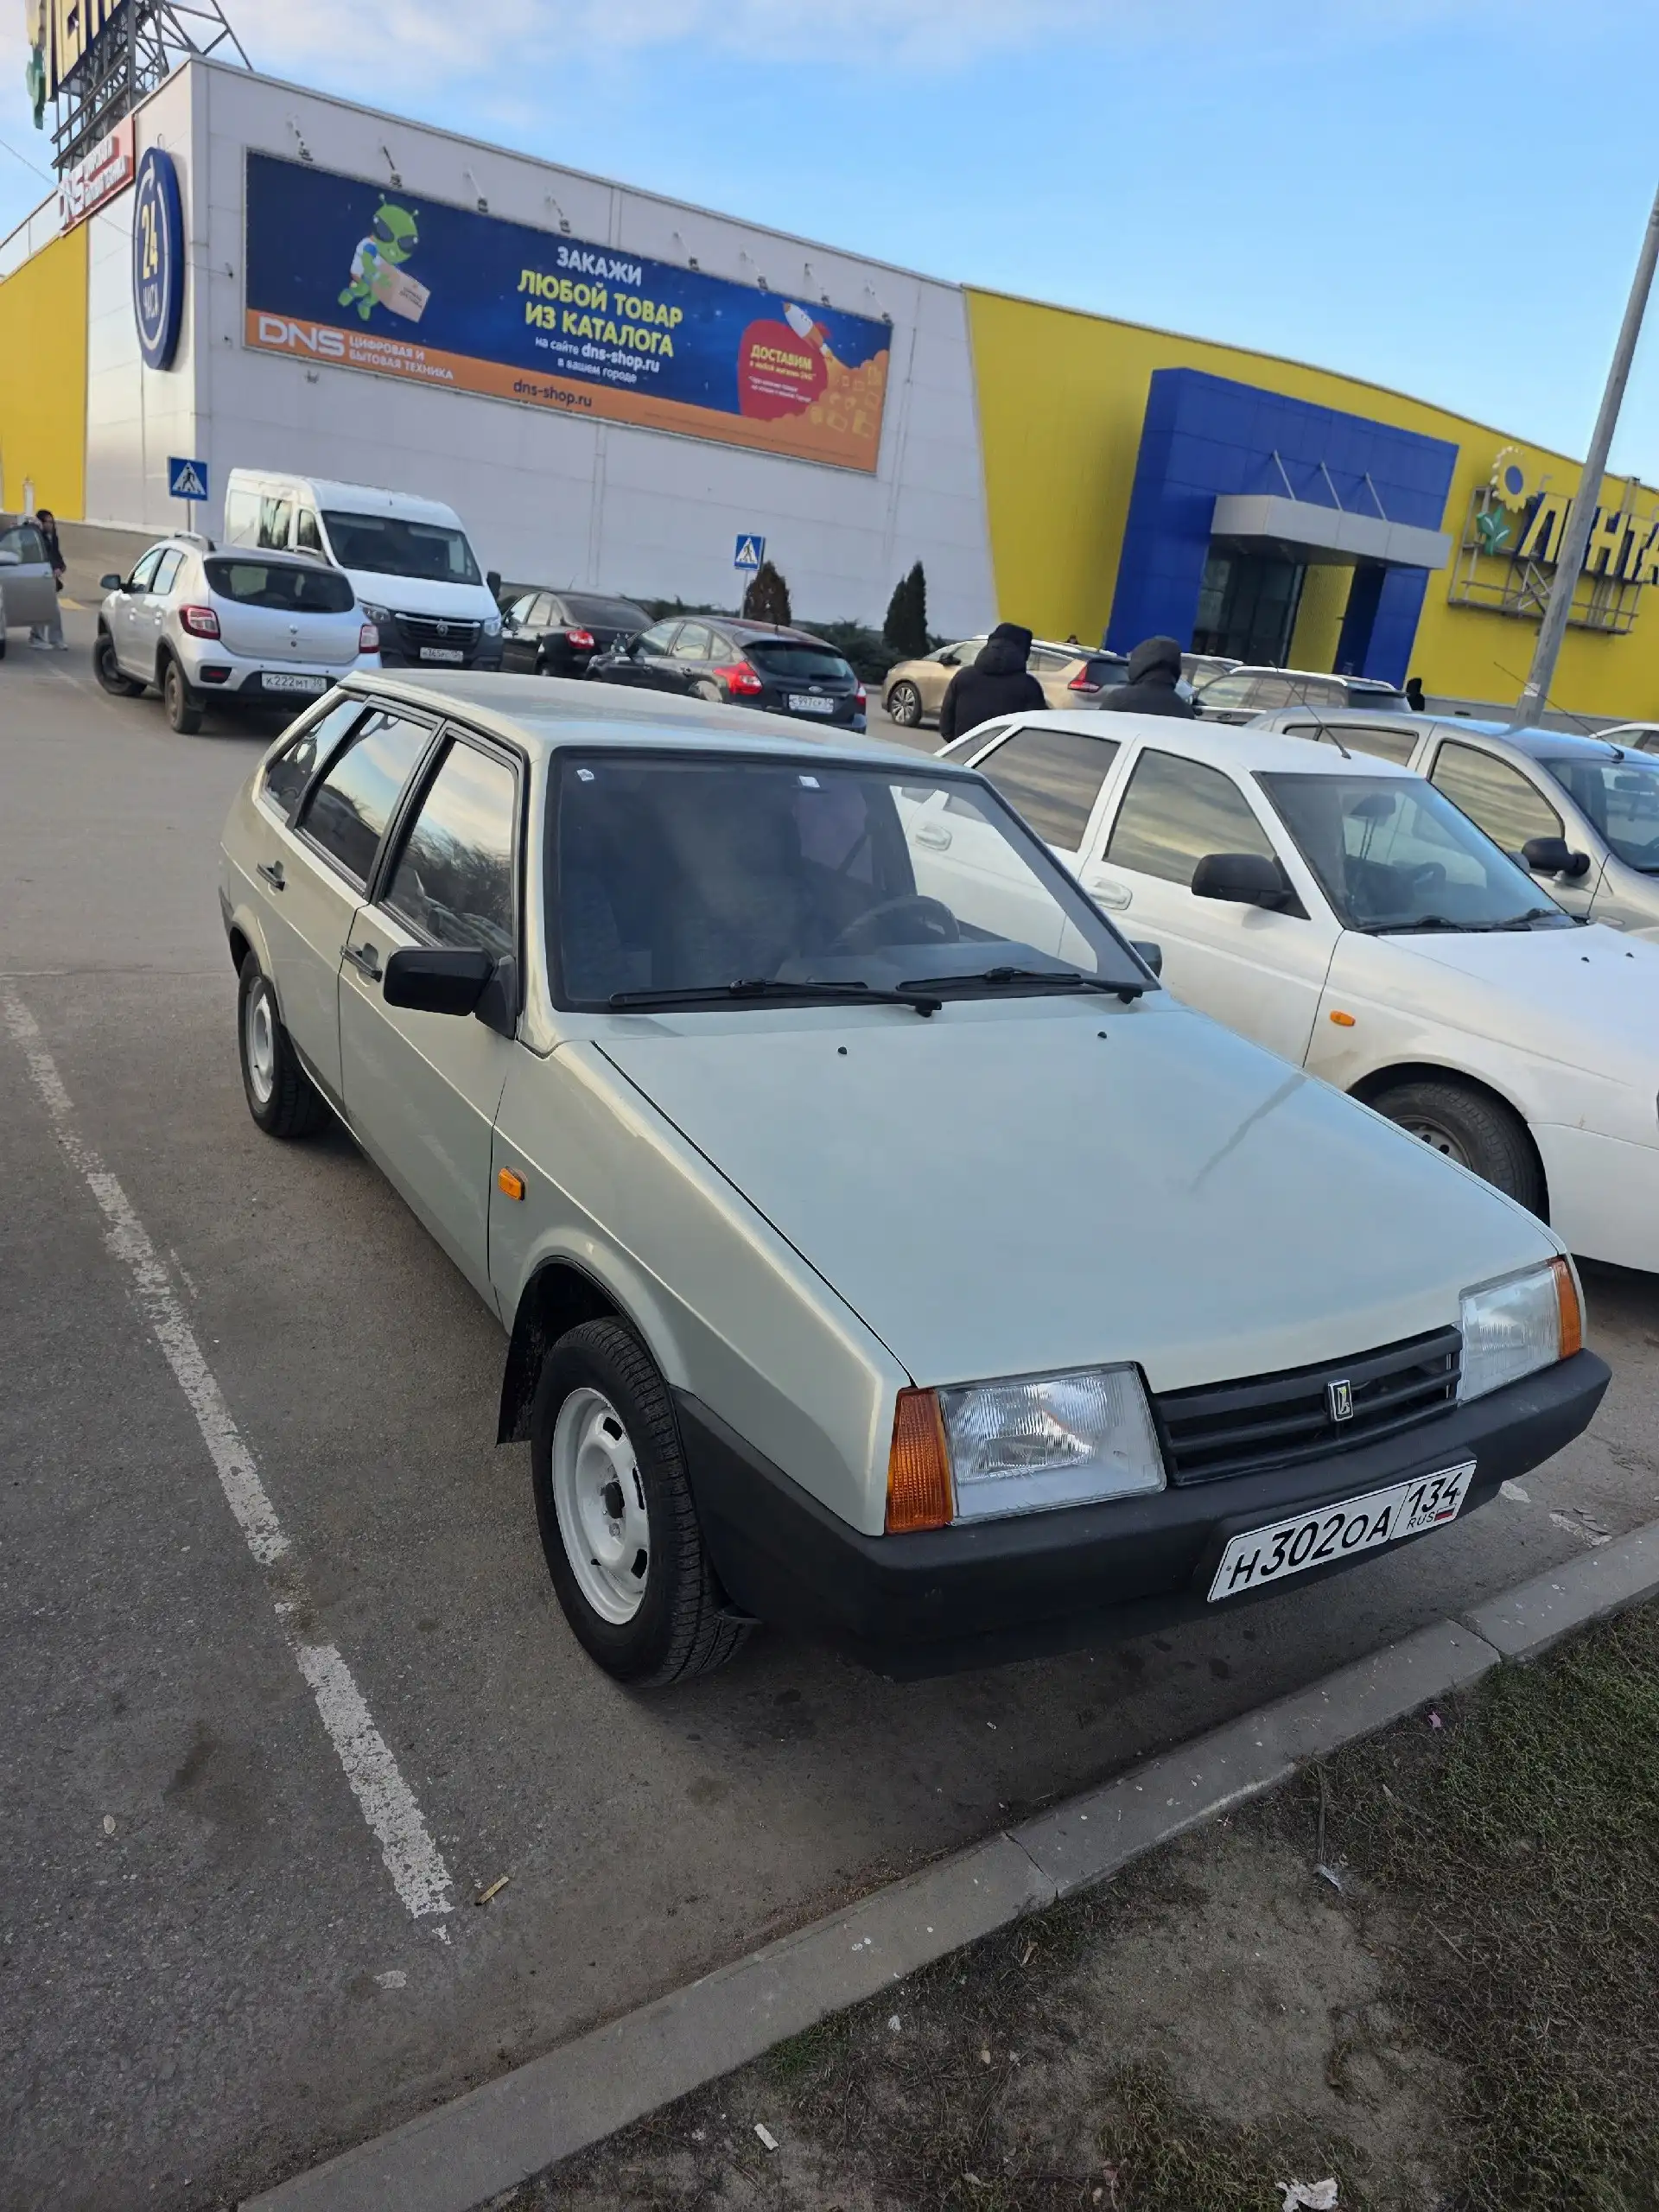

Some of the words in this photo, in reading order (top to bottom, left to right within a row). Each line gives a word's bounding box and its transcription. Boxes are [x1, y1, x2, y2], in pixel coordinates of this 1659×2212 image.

[141, 200, 158, 280] 24
[556, 246, 642, 287] ЗАКАЖИ
[518, 270, 607, 311] ЛЮБОЙ
[613, 292, 683, 328] ТОВАР
[259, 315, 345, 357] DNS
[349, 334, 413, 359] ЦИФРОВАЯ
[416, 350, 425, 361] И
[525, 302, 556, 330] ИЗ
[563, 310, 674, 358] КАТАЛОГА
[349, 349, 402, 369] БЫТОВАЯ
[404, 360, 454, 379] ТЕХНИКА
[535, 336, 549, 349] на
[581, 343, 660, 372] dns-shop.ru
[513, 379, 593, 408] dns-shop.ru
[1516, 492, 1659, 584] ЛНТА
[1227, 1505, 1392, 1590] Н302ОА
[1408, 1471, 1463, 1517] 134
[1406, 1512, 1434, 1529] RUS
